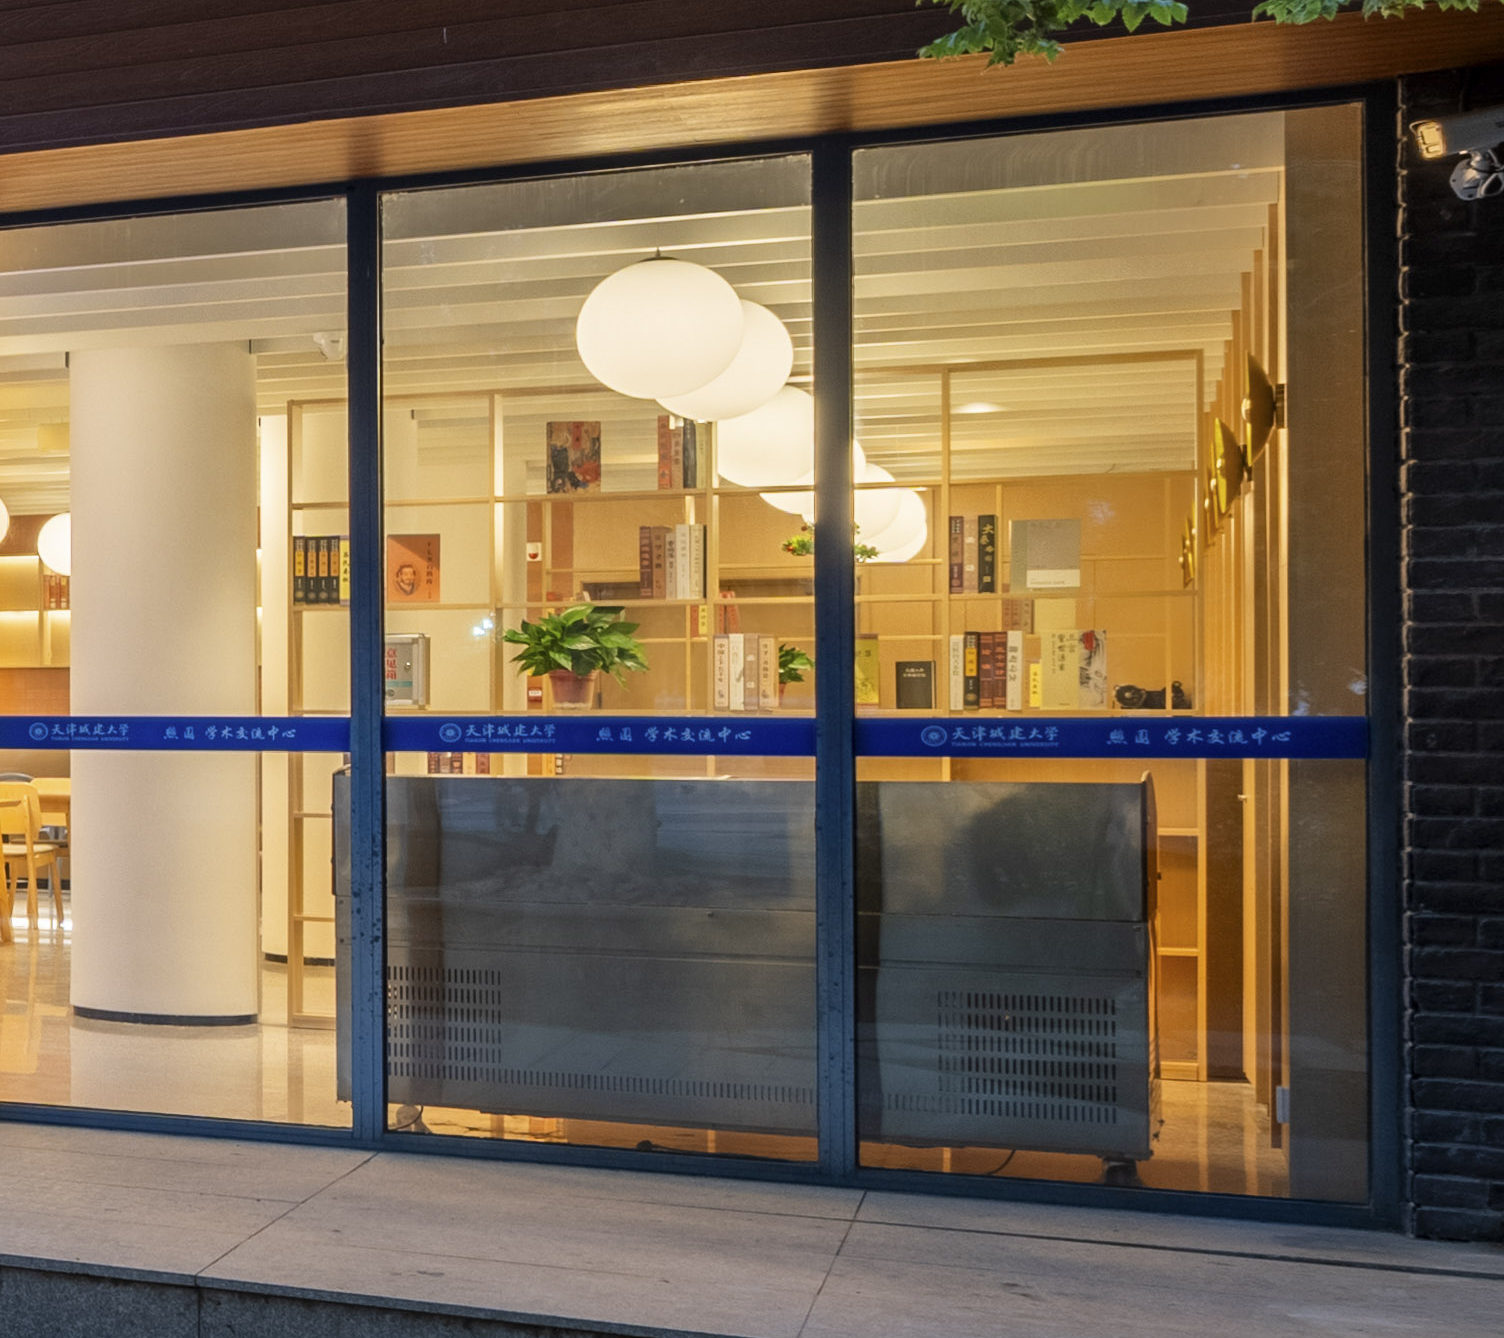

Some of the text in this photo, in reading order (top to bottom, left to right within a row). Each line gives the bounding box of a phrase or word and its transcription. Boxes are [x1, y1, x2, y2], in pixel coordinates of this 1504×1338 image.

[644, 726, 752, 743] 学术交流中心
[1164, 727, 1292, 746] 学术交流中心
